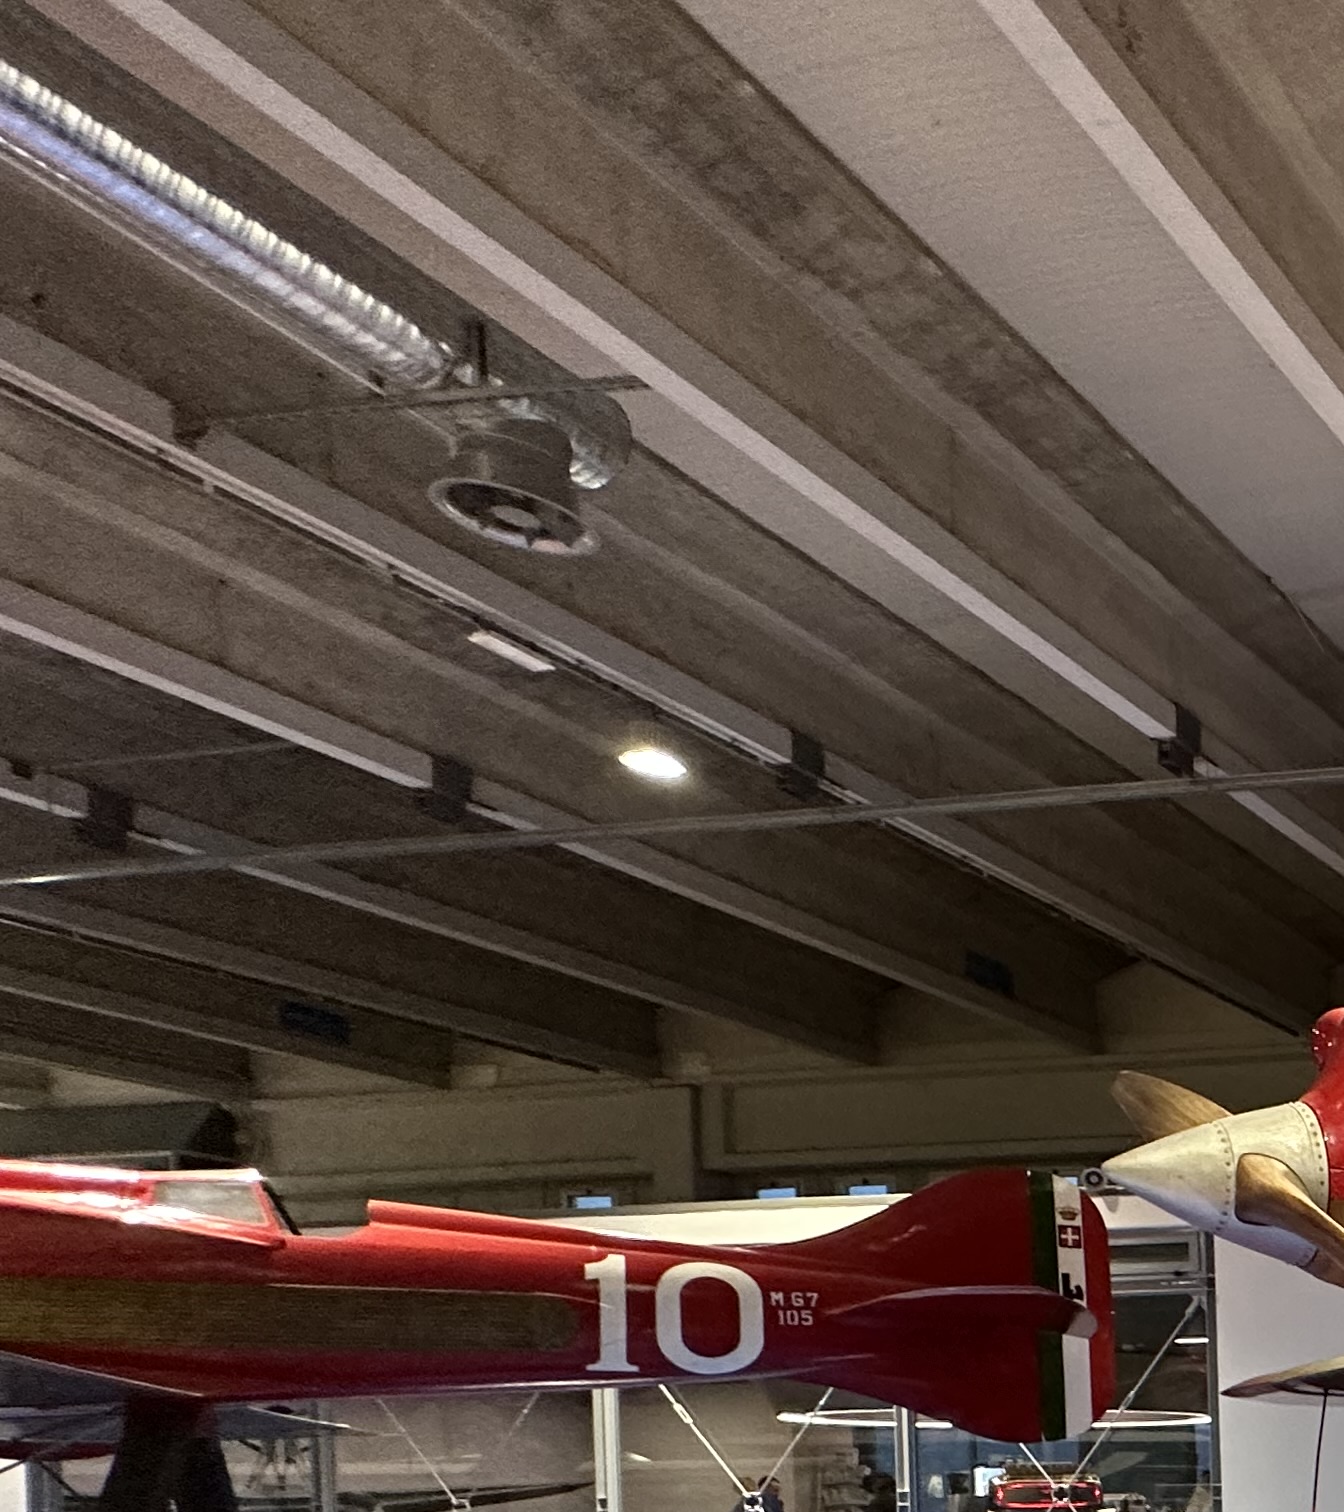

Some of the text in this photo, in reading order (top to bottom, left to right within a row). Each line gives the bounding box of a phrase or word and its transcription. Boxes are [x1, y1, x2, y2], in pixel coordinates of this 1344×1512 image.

[769, 1291, 785, 1307] M
[584, 1253, 765, 1375] 10
[777, 1309, 814, 1326] 105
